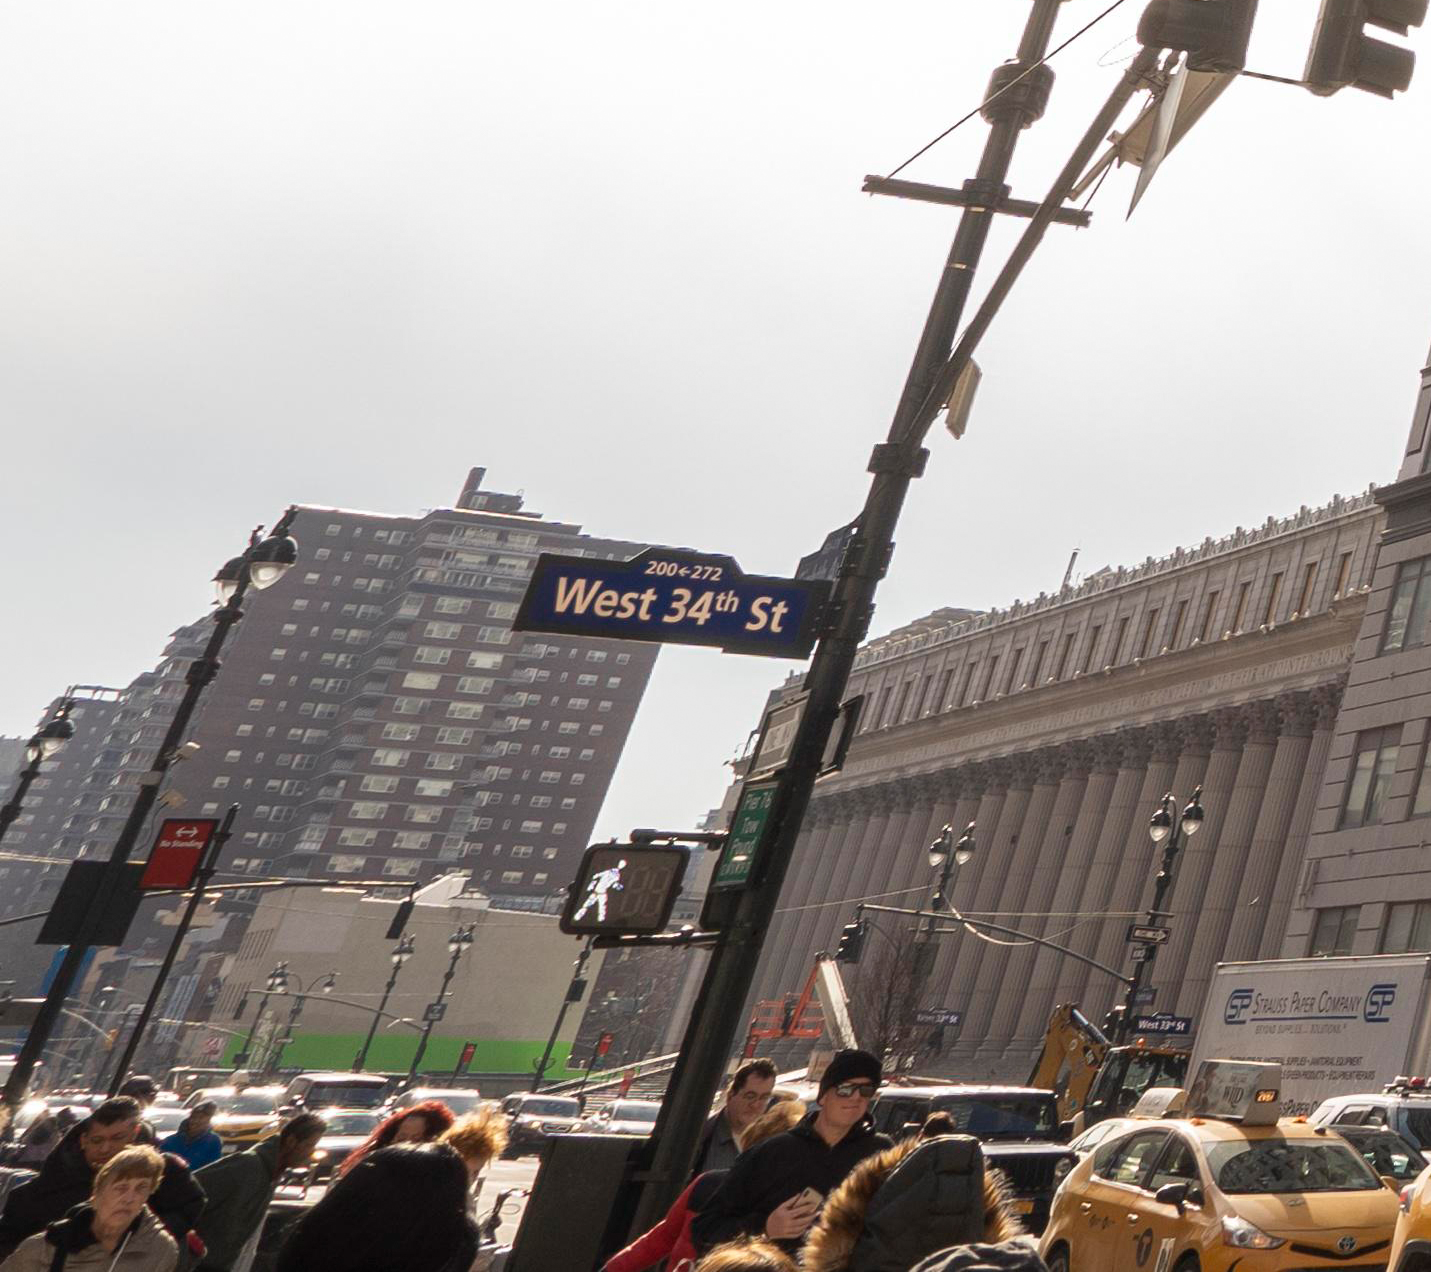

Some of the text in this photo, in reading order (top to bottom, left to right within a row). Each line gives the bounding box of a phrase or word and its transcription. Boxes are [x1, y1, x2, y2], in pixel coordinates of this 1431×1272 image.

[644, 560, 724, 582] 200 272
[553, 576, 789, 634] West 34th St
[1252, 990, 1363, 1015] STRAUSS PAPER COMPANY
[1138, 1019, 1159, 1030] West
[1177, 1021, 1186, 1032] St
